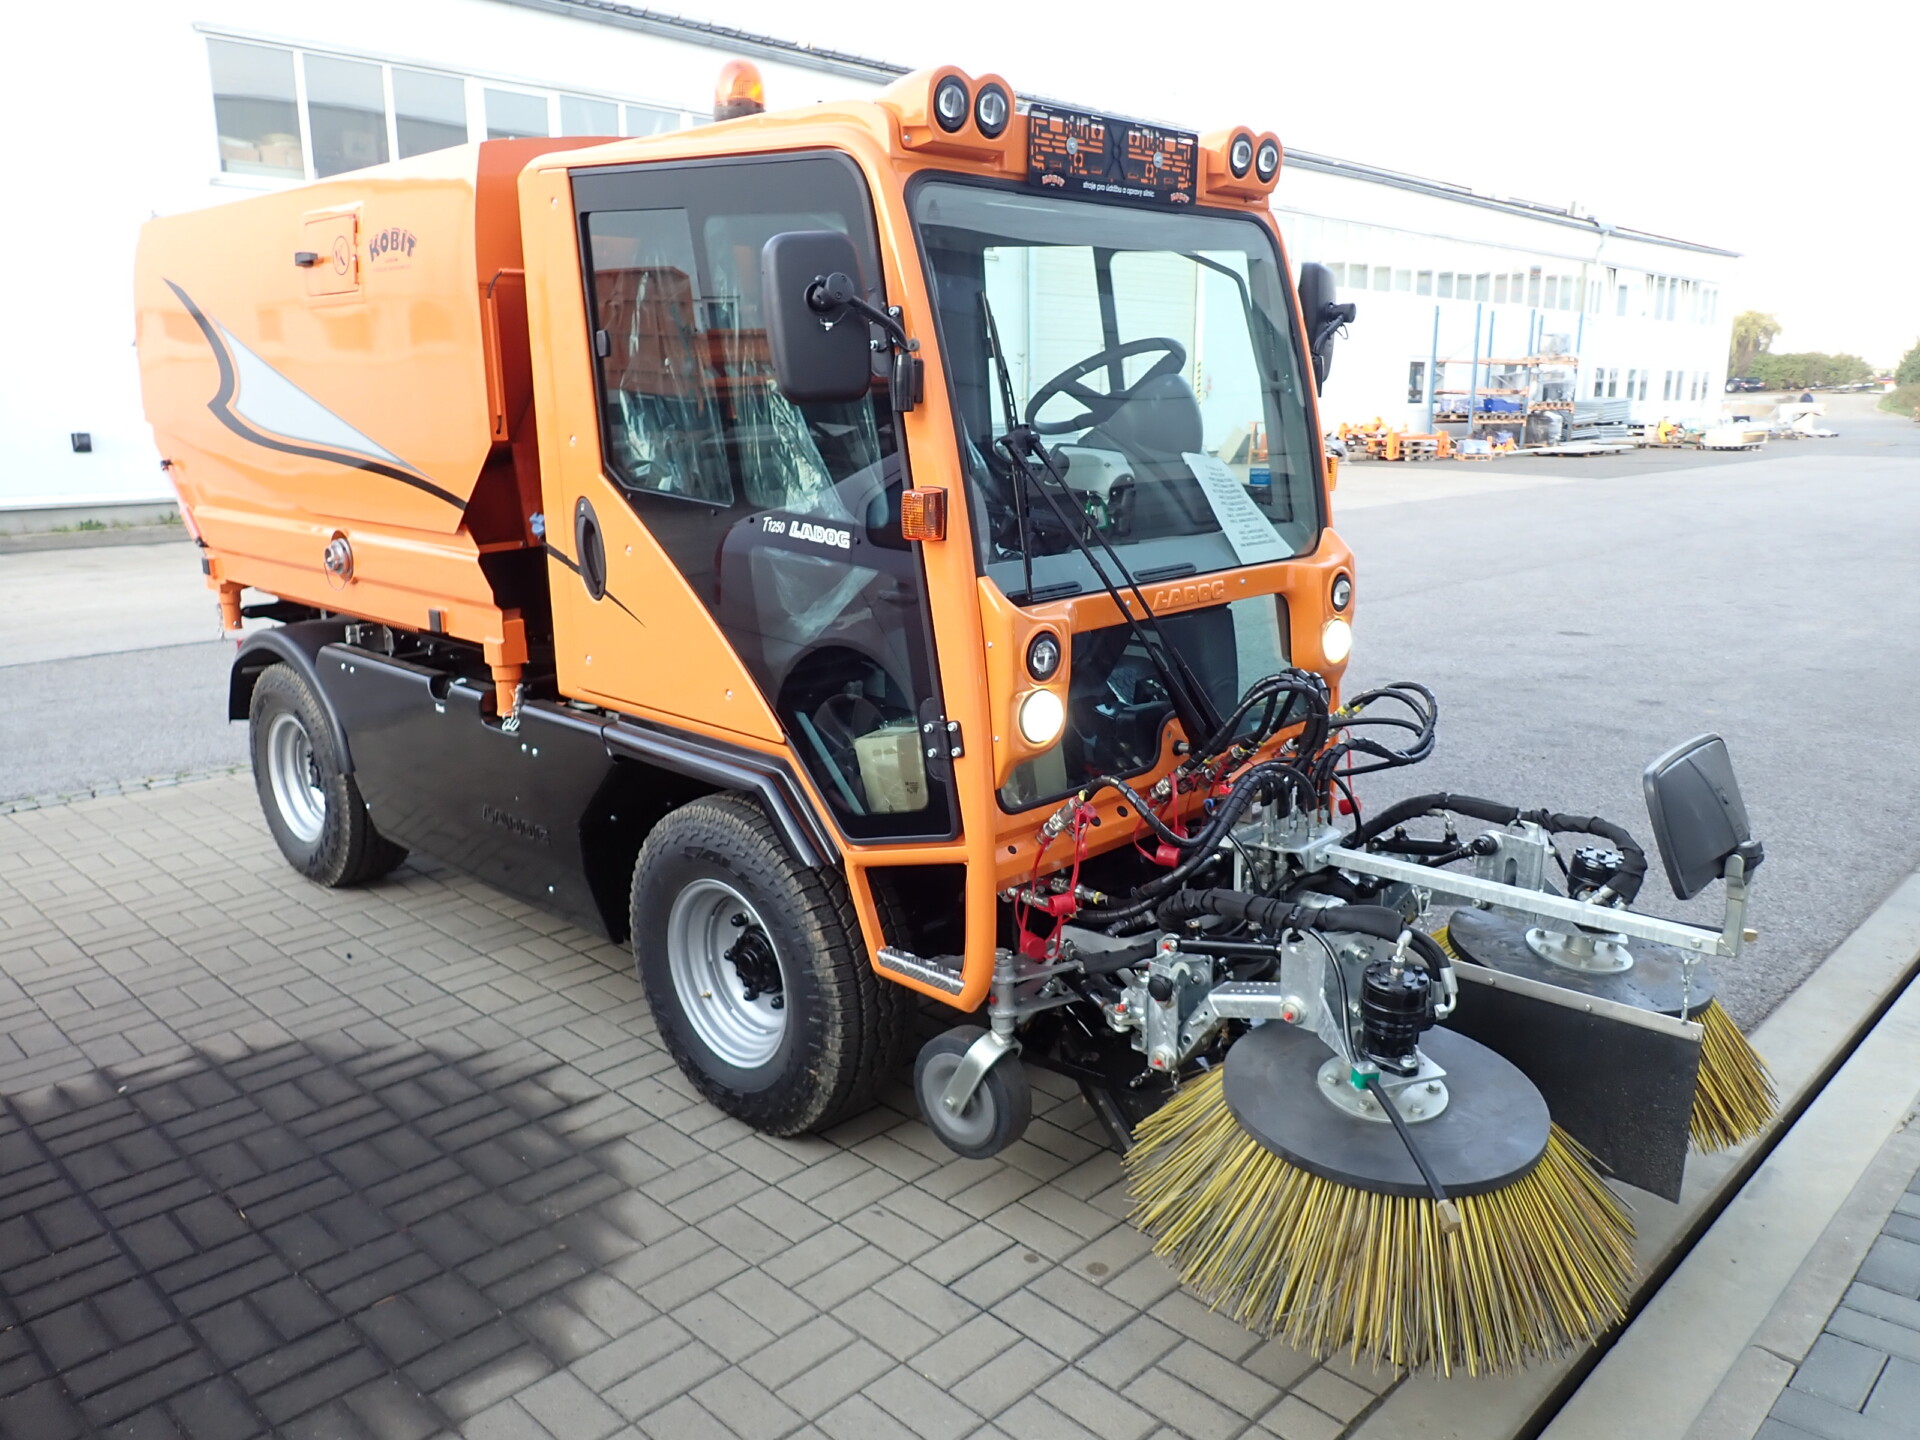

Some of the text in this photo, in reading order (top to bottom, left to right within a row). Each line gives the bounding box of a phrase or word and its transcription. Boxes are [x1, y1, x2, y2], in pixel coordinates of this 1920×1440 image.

[369, 228, 417, 262] KOBIT
[763, 516, 850, 549] T1250 LADOG
[1153, 580, 1224, 611] LADOG
